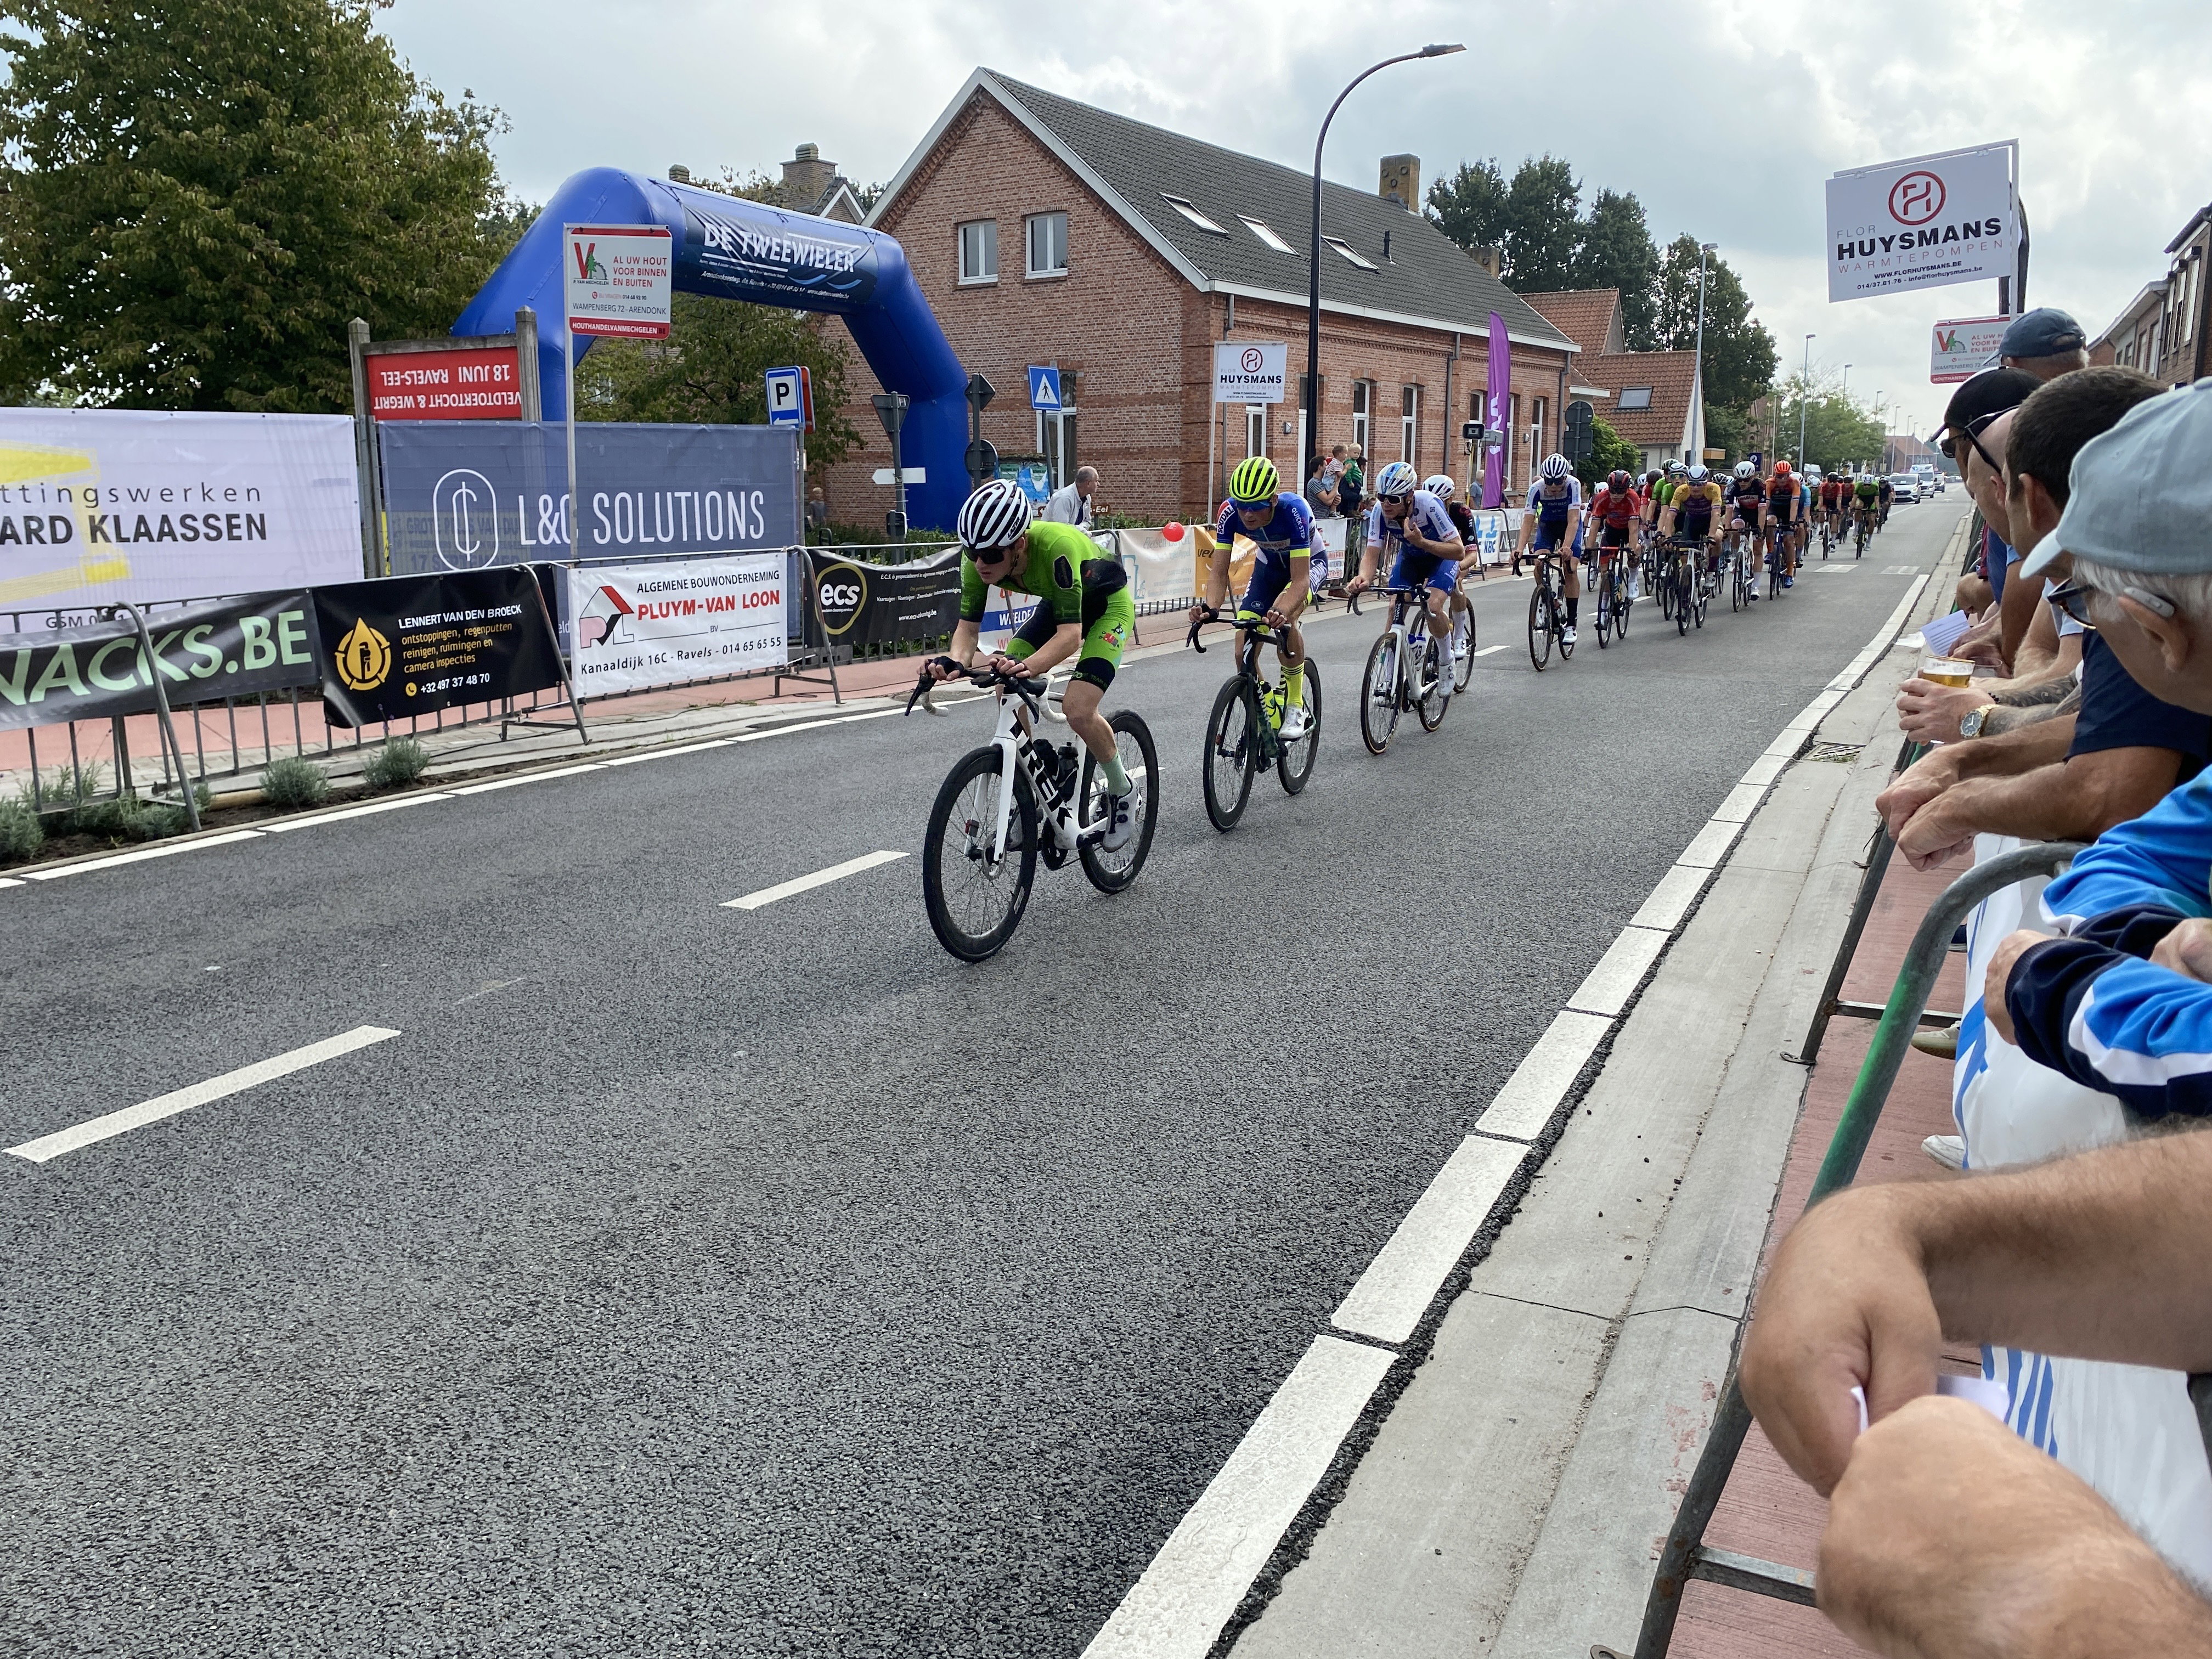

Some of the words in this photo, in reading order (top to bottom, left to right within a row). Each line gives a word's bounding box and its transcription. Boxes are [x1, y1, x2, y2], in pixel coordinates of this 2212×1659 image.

[1837, 224, 1876, 239] FLOR
[1837, 217, 2002, 261] HUYSMANS
[704, 222, 733, 251] DE
[741, 230, 854, 273] TWEEWIELER
[1838, 239, 2002, 274] WARMTEPOMPEN
[613, 256, 623, 264] AL
[627, 256, 640, 264] UW
[643, 257, 667, 266] HOUT
[1874, 261, 1962, 279] WWW.FLORHUYSMANS.BE
[637, 268, 667, 277] BINNEN
[625, 279, 652, 287] BUITEN
[573, 303, 616, 312] WAMPENBERG
[629, 306, 667, 315] ARENDONK
[380, 369, 449, 386] RAVELS-EEL
[458, 365, 490, 383] JUNI
[493, 364, 510, 381] 18
[1220, 375, 1282, 383] HUYSMANS
[374, 396, 415, 410] WEGRIT
[417, 395, 426, 408] &
[429, 391, 521, 408] VELDTOERTOCHT
[776, 382, 789, 405] P
[0, 482, 261, 508] ttingswerken
[592, 490, 764, 544] SOLUTIONS
[1218, 506, 1234, 534] SOUDAL
[0, 515, 72, 545] ARD
[88, 513, 267, 544] KLAASSEN
[637, 579, 689, 594] ALGEMENE
[691, 570, 780, 588] BOUWONDERNEMING
[820, 583, 860, 606] ecs
[637, 595, 735, 620] PLUYM-VAN
[743, 590, 780, 609] LOON
[398, 613, 441, 629] LENNERT
[443, 612, 463, 622] VAN
[465, 610, 484, 620] DEN
[487, 604, 522, 618] BROECK
[402, 629, 461, 646] ontstoppingen,
[464, 623, 512, 637] regenputten
[710, 625, 719, 633] BV
[403, 645, 438, 659] reinigen,
[440, 640, 482, 653] ruimingen
[483, 638, 493, 647] en
[581, 655, 644, 675] Kanaaldijk
[648, 652, 668, 665] 16C
[678, 647, 712, 661] Ravels
[722, 642, 740, 656] 014
[743, 640, 754, 651] 65
[757, 638, 768, 650] 65
[770, 636, 781, 648] 55
[404, 661, 435, 674] camera
[436, 654, 476, 669] inspecties
[421, 683, 436, 693] +32
[437, 679, 449, 690] 497
[452, 676, 464, 687] 37
[466, 675, 477, 685] 48
[479, 673, 490, 684] 70
[1009, 709, 1073, 830] TREK
